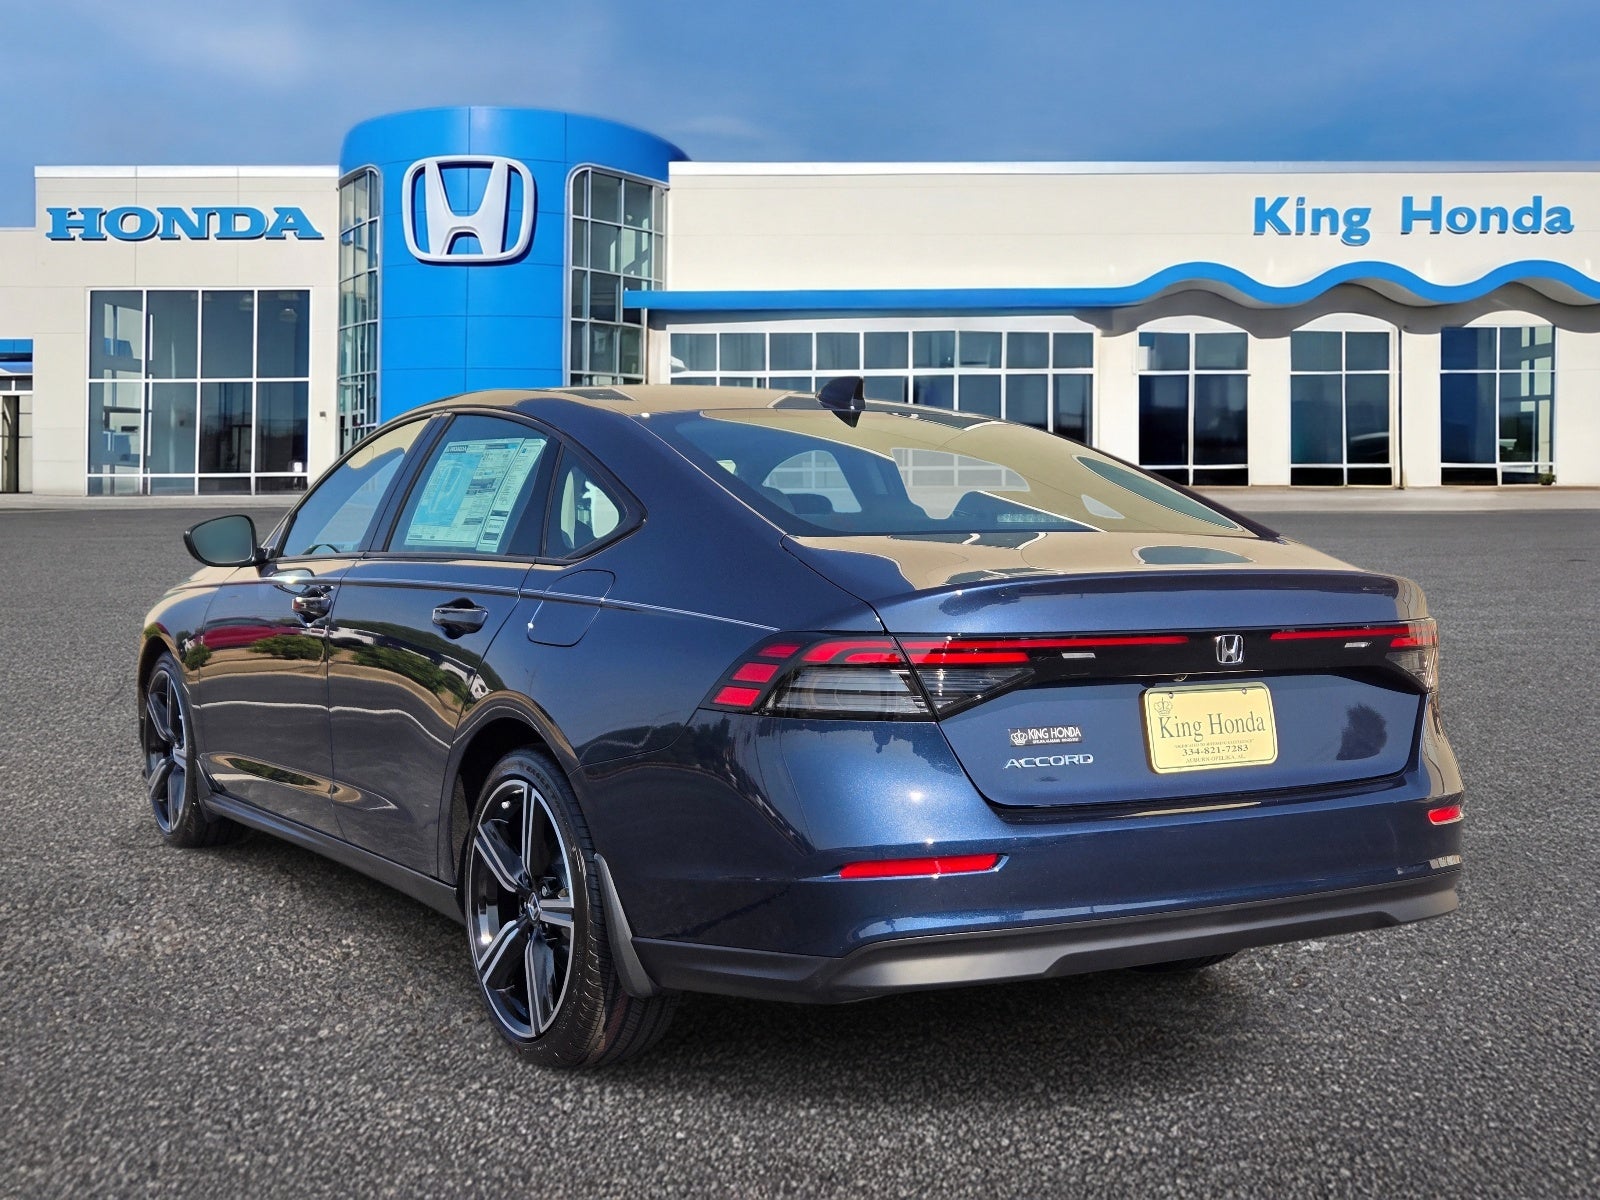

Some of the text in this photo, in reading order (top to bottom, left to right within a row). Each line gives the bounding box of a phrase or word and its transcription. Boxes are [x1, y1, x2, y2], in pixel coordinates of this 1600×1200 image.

[45, 206, 325, 241] HONDA
[1253, 195, 1575, 246] King Honda
[1027, 726, 1082, 740] KING HONDA
[1158, 710, 1266, 743] King Honda
[1003, 753, 1094, 770] ACCORD
[1182, 744, 1249, 757] 334-821-7283
